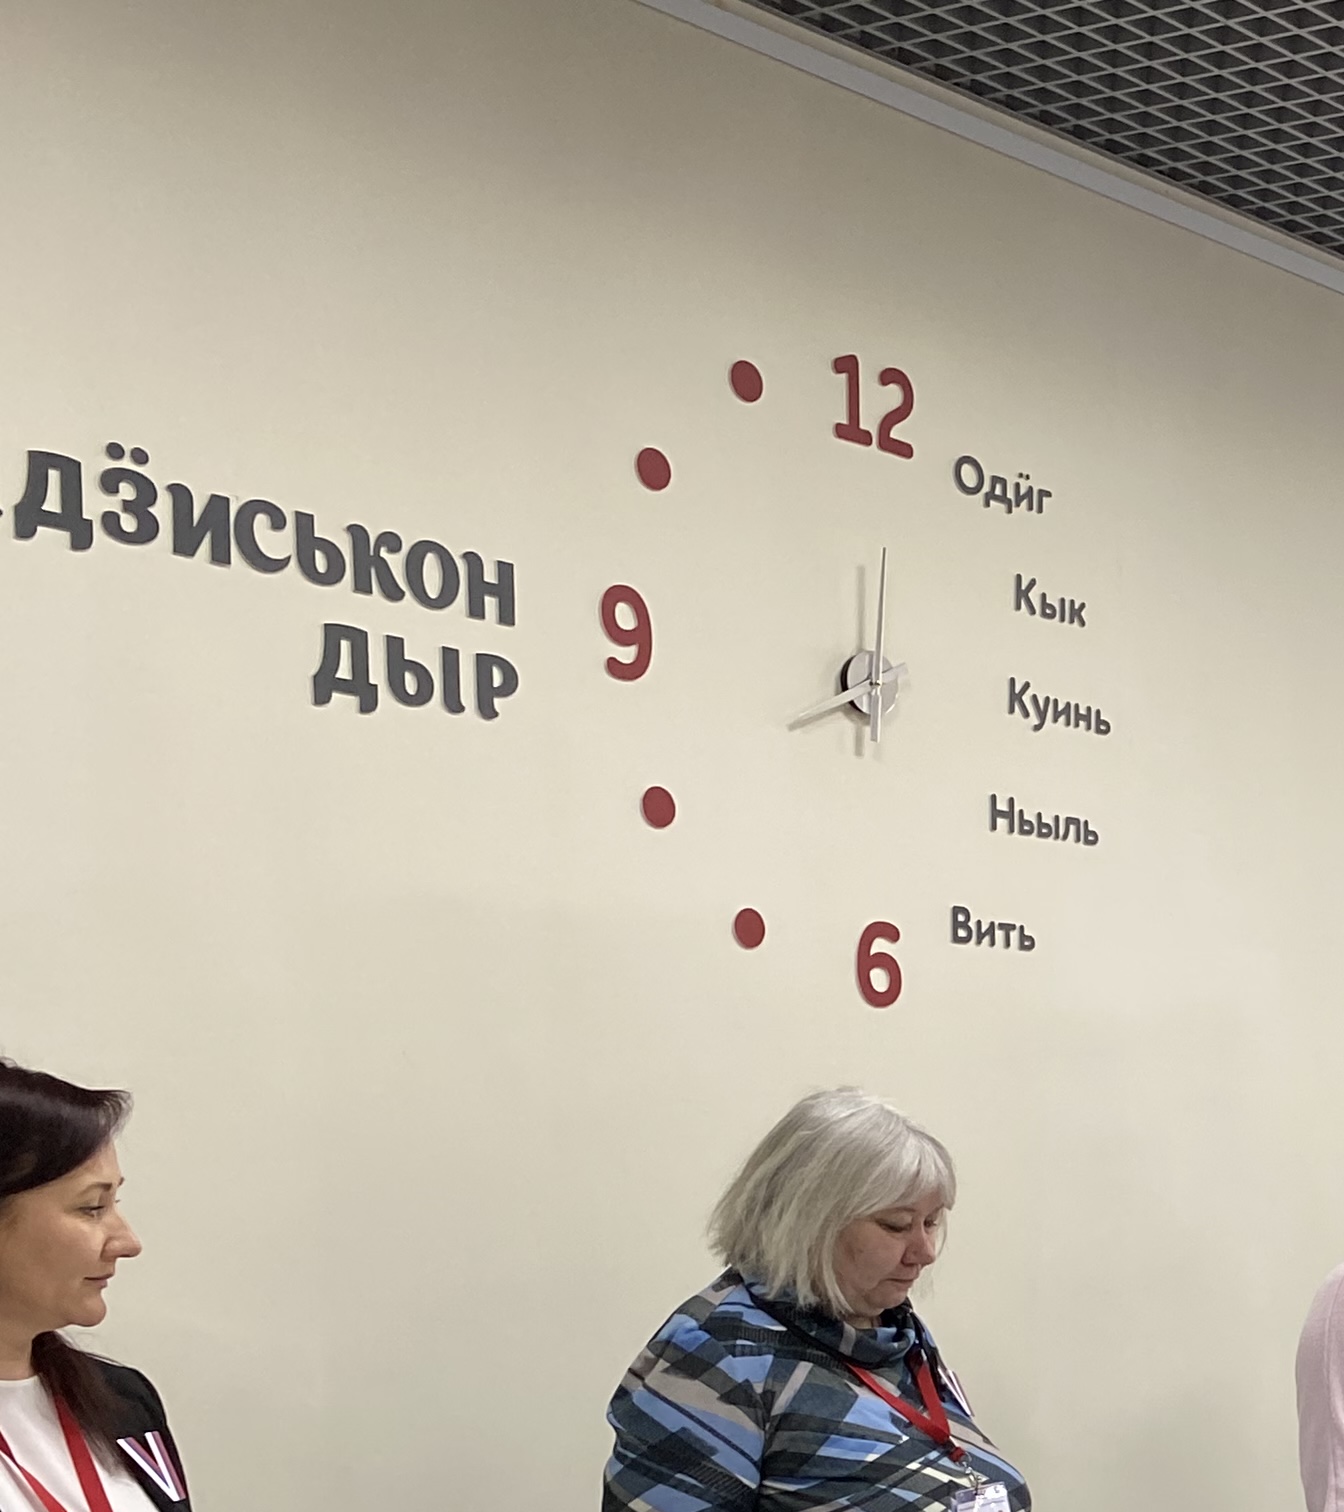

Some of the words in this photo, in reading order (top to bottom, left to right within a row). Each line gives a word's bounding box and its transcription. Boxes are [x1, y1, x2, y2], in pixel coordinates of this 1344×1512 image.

[832, 355, 914, 459] 12
[954, 455, 1053, 514] Одӥг
[1015, 573, 1087, 628] Кык
[601, 585, 652, 681] 9
[1008, 676, 1112, 736] Куинь
[989, 793, 1100, 846] Ньыль
[951, 905, 1036, 952] Вить
[857, 922, 902, 1007] 6
